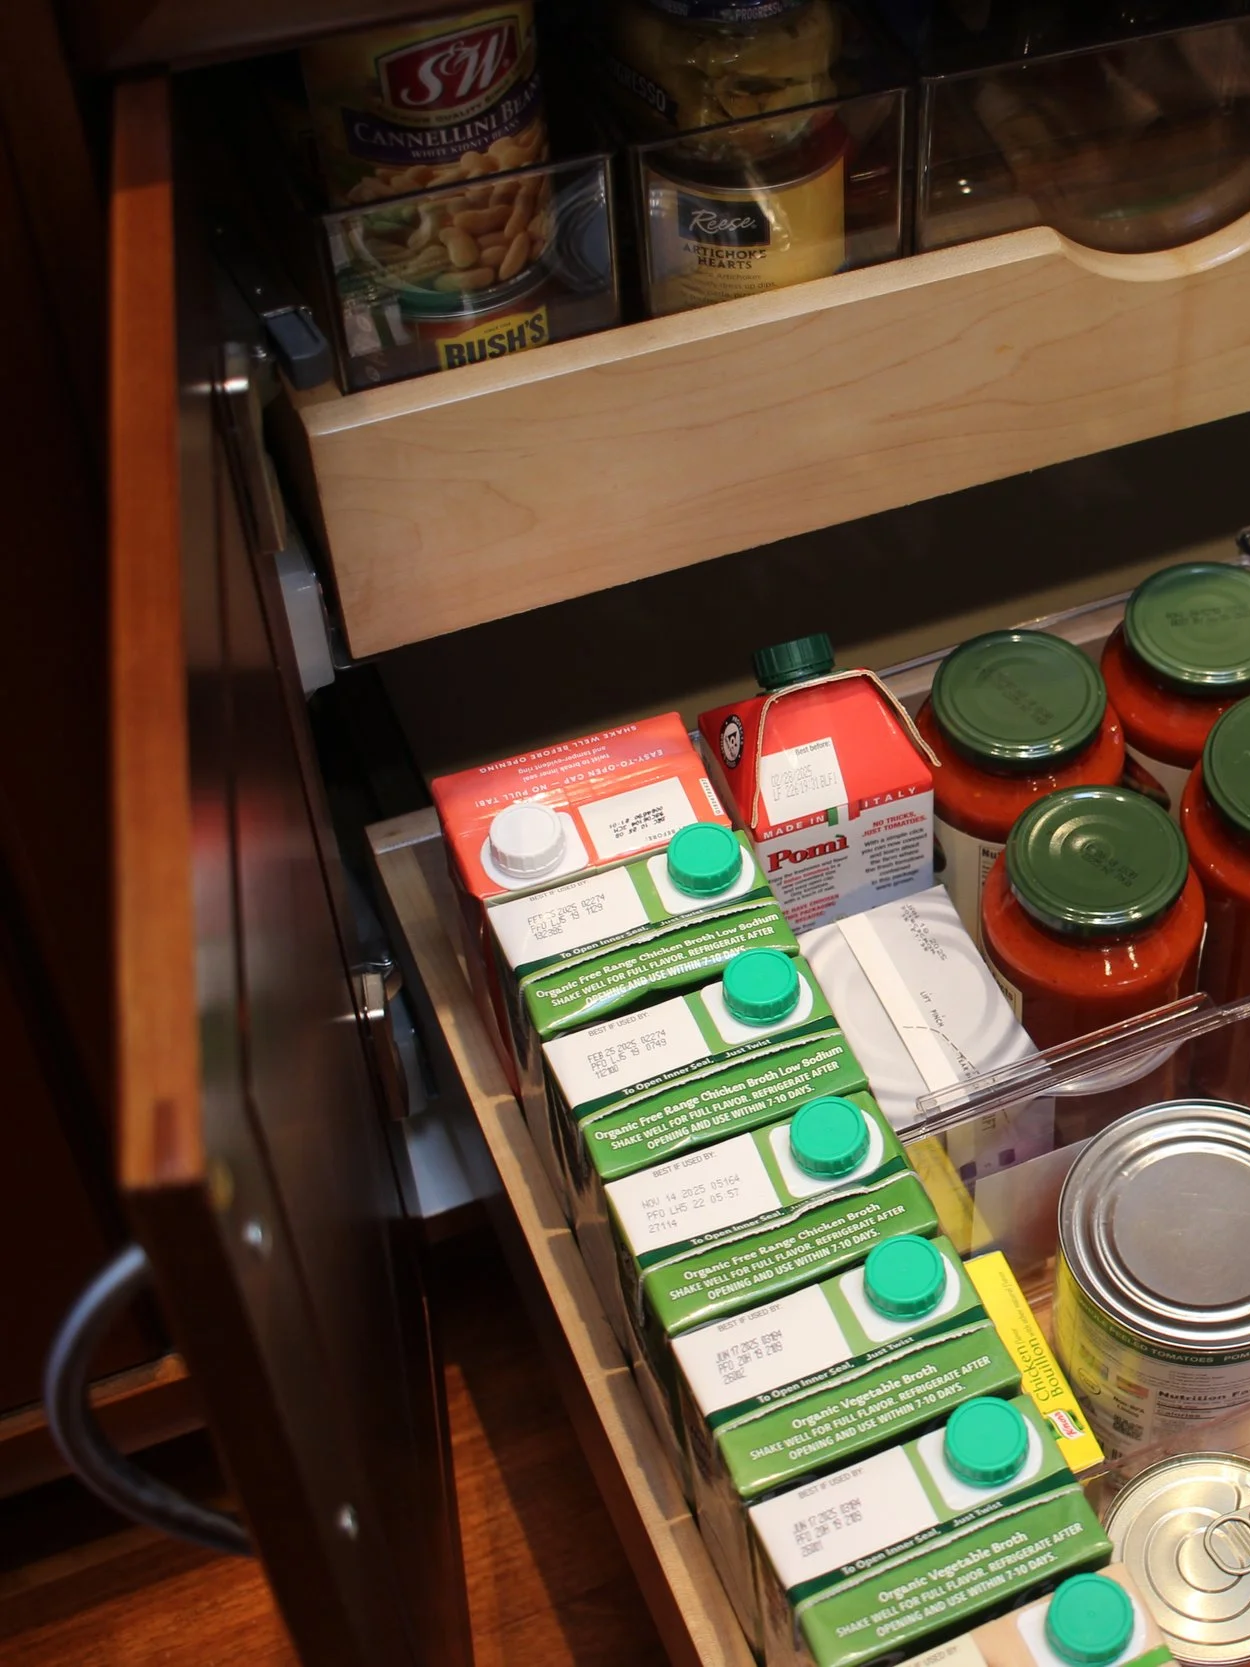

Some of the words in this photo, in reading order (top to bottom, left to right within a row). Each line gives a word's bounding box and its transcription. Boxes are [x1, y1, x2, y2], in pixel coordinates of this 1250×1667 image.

[400, 25, 509, 105] S&W
[354, 113, 497, 148] CANNELLINI
[688, 208, 755, 234] Reese
[683, 243, 768, 260] ARTICHOKE
[697, 256, 752, 270] HEARTS
[444, 313, 545, 370] BUSH'S
[570, 735, 600, 748] WELL
[602, 723, 637, 739] SHAKE
[529, 743, 570, 760] BEFORE
[586, 747, 664, 778] EASY-TO-OPEN
[794, 745, 809, 756] Best
[808, 739, 831, 752] before:
[477, 755, 527, 774] OPENING
[562, 771, 585, 785] CAP
[473, 794, 499, 808] TAB!
[501, 787, 528, 801] PULL
[529, 782, 548, 794] NO
[761, 820, 805, 840] MADE
[808, 814, 825, 825] IN
[862, 785, 918, 808] ITALY
[860, 825, 883, 837] JUST
[882, 813, 928, 831] TOMATOES.
[871, 818, 884, 827] NO
[884, 810, 917, 824] TRICKS,
[536, 981, 578, 998] Organic
[579, 971, 602, 984] Free
[602, 959, 637, 974] Range
[639, 944, 683, 961] Chicken
[684, 933, 715, 946] Broth
[715, 928, 737, 937] Low
[738, 914, 779, 931] Sodium
[551, 991, 582, 1006] SHAKE
[581, 981, 607, 994] WELL
[607, 973, 626, 984] FOR
[626, 965, 649, 977] FULL
[649, 953, 687, 969] FLAVOR.
[688, 934, 746, 956] REFRIGERATE
[747, 926, 775, 939] AFTER
[919, 991, 931, 1002] LIFT
[931, 1009, 944, 1027] PINCH
[621, 1085, 635, 1095] To
[635, 1076, 664, 1090] Open
[661, 1067, 689, 1080] Inner
[689, 1058, 717, 1070] Seal,
[723, 1047, 747, 1058] Just
[744, 1039, 773, 1050] Twist
[595, 1122, 639, 1140] Organic
[639, 1112, 664, 1126] Free
[663, 1097, 700, 1115] Range
[700, 1083, 746, 1101] Chicken
[746, 1071, 779, 1087] Broth
[778, 1063, 801, 1076] Low
[801, 1047, 843, 1067] Sodium
[611, 1133, 643, 1149] SHAKE
[643, 1123, 669, 1138] WELL
[669, 1115, 689, 1128] FOR
[688, 1107, 713, 1119] FULL
[712, 1095, 751, 1112] FLAVOR.
[751, 1072, 811, 1099] REFRIGERATE
[812, 1061, 839, 1078] AFTER
[647, 1126, 692, 1149] OPENING
[691, 1119, 711, 1132] AND
[711, 1113, 731, 1125] USE
[730, 1101, 767, 1118] WITHIN
[766, 1094, 787, 1106] 7-10
[787, 1084, 815, 1099] DAYS.
[669, 1282, 703, 1300] SHAKE
[703, 1274, 730, 1287] WELL
[730, 1266, 751, 1278] FOR
[751, 1258, 775, 1271] FULL
[775, 1243, 815, 1262] FLAVOR.
[815, 1217, 876, 1246] REFRIGERATE
[877, 1205, 905, 1222] AFTER
[683, 1261, 731, 1280] Organic
[731, 1252, 758, 1265] Free
[758, 1237, 796, 1255] Range
[798, 1218, 846, 1240] Chicken
[846, 1204, 881, 1221] Broth
[707, 1278, 752, 1300] OPENING
[753, 1270, 774, 1283] AND
[774, 1261, 794, 1275] USE
[793, 1247, 831, 1267] WITHIN
[831, 1239, 852, 1253] 7-10
[852, 1228, 880, 1244] DAYS.
[1028, 1336, 1063, 1400] Bouillon
[1150, 1348, 1214, 1363] TOMATOES
[1016, 1343, 1050, 1402] Chicken
[750, 1442, 784, 1460] SHAKE
[783, 1432, 812, 1447] WELL
[811, 1423, 833, 1437] FOR
[832, 1414, 858, 1428] FULL
[857, 1397, 898, 1418] FLAVOR.
[898, 1369, 961, 1401] REFRIGERATE
[961, 1356, 991, 1375] AFTER
[792, 1405, 840, 1429] Organic
[840, 1380, 902, 1408] Vegetable
[902, 1364, 937, 1384] Broth
[1157, 1388, 1226, 1404] Nutrition
[789, 1436, 834, 1460] OPENING
[835, 1427, 857, 1442] AND
[857, 1418, 878, 1432] USE
[876, 1403, 915, 1424] WITHIN
[914, 1394, 937, 1408] 7-10
[936, 1382, 966, 1399] DAYS.
[1054, 1410, 1078, 1439] Knorr
[878, 1577, 928, 1602] Organic
[927, 1549, 996, 1580] Vegetable
[991, 1532, 1028, 1553] Broth
